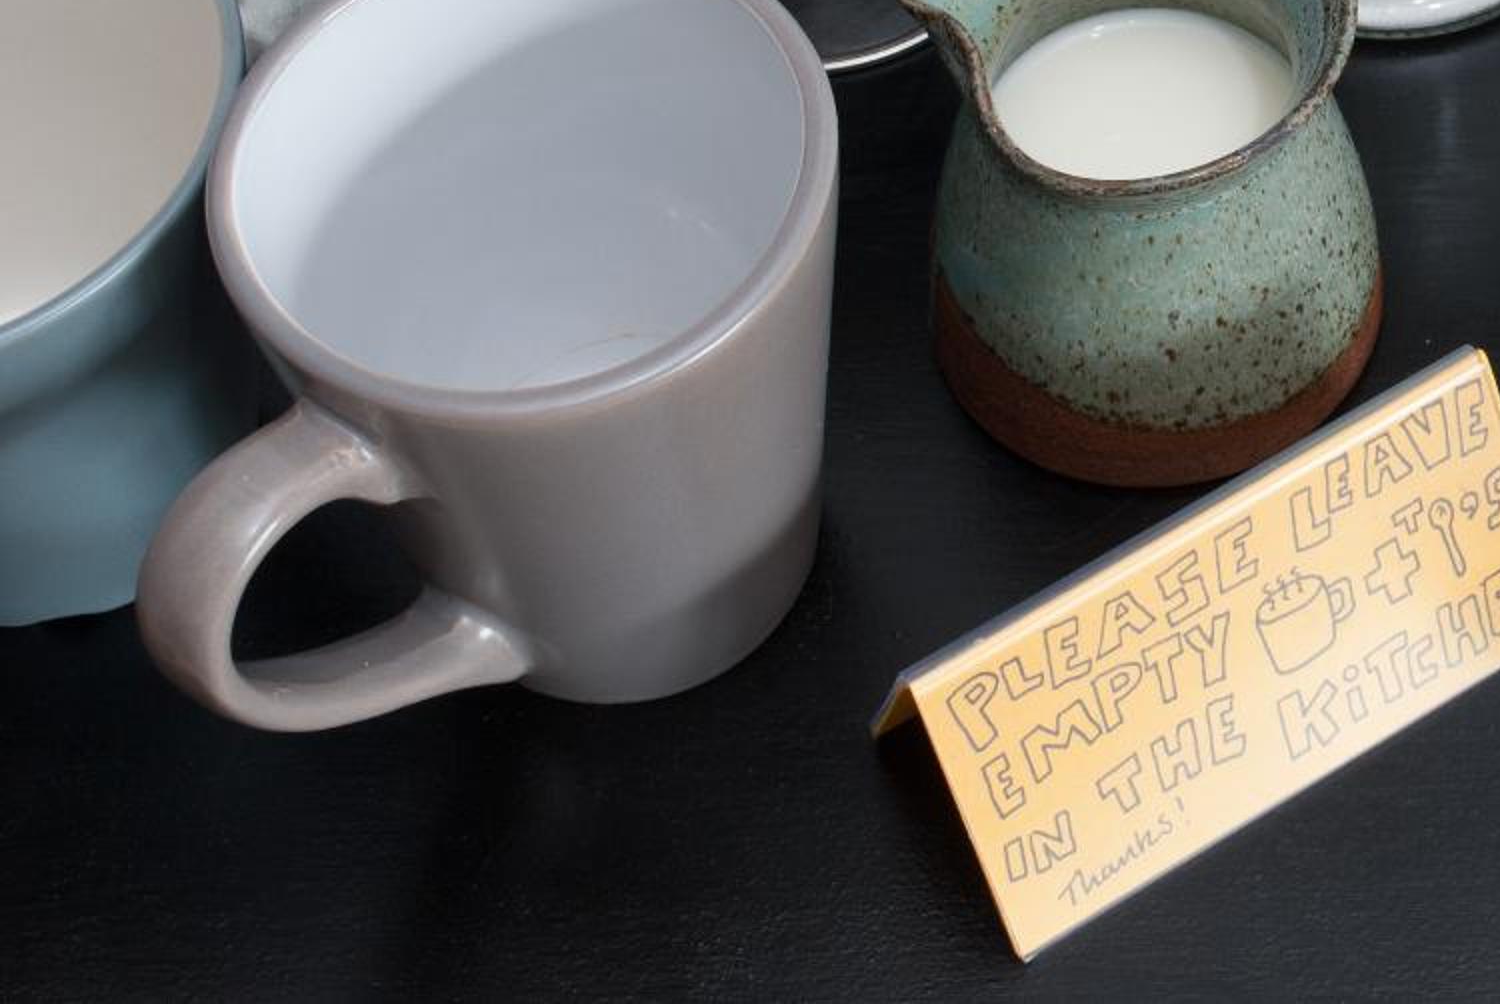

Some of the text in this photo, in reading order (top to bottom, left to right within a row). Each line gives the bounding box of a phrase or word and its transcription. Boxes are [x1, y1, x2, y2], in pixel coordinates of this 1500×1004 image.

[945, 377, 1489, 753] PLEASE LEAVE
[982, 611, 1231, 819] EMPTY
[1003, 809, 1078, 883] IN
[1095, 693, 1248, 814] THE
[1057, 797, 1194, 907] Thanks!
